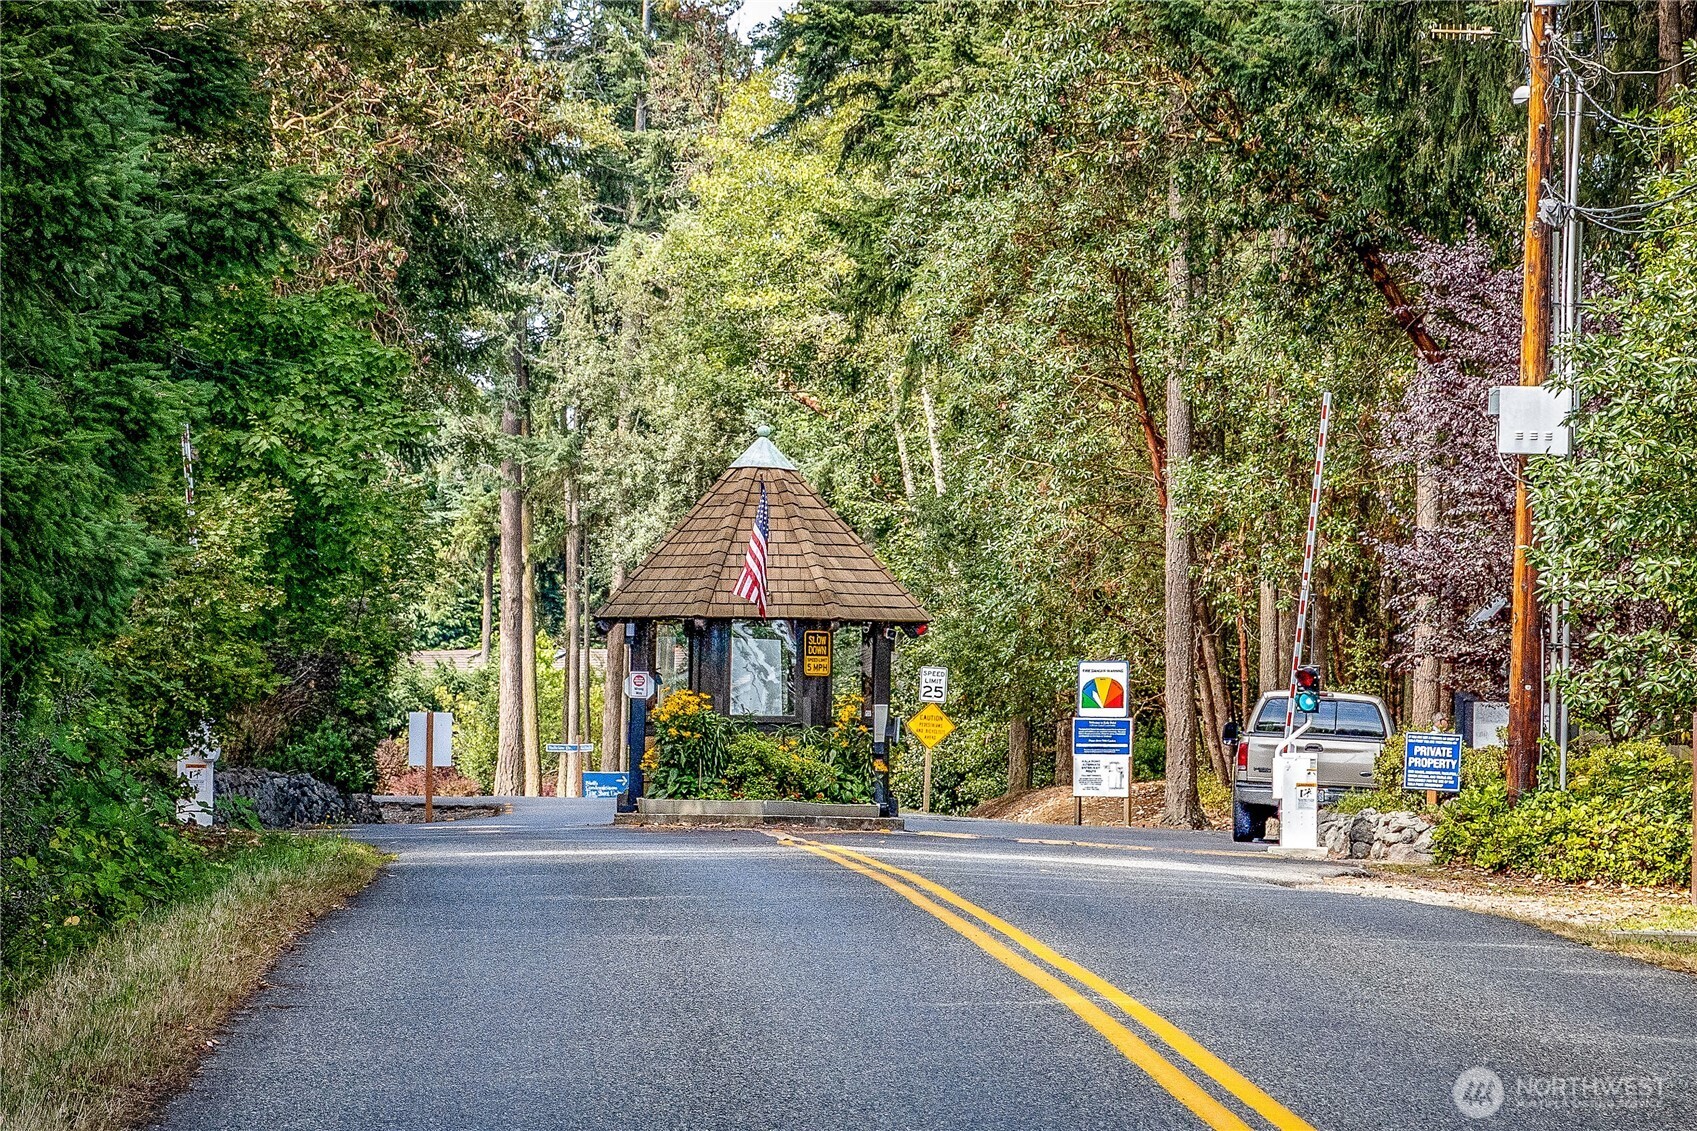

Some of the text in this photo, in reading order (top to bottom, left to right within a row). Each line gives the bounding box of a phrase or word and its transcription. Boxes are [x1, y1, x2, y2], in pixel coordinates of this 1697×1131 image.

[808, 635, 827, 645] SLOW
[808, 645, 827, 655] DOWN
[807, 663, 828, 671] 5 MPH
[922, 685, 944, 698] 25
[1413, 745, 1453, 757] PRIVATE
[1408, 757, 1457, 769] PROPERTY
